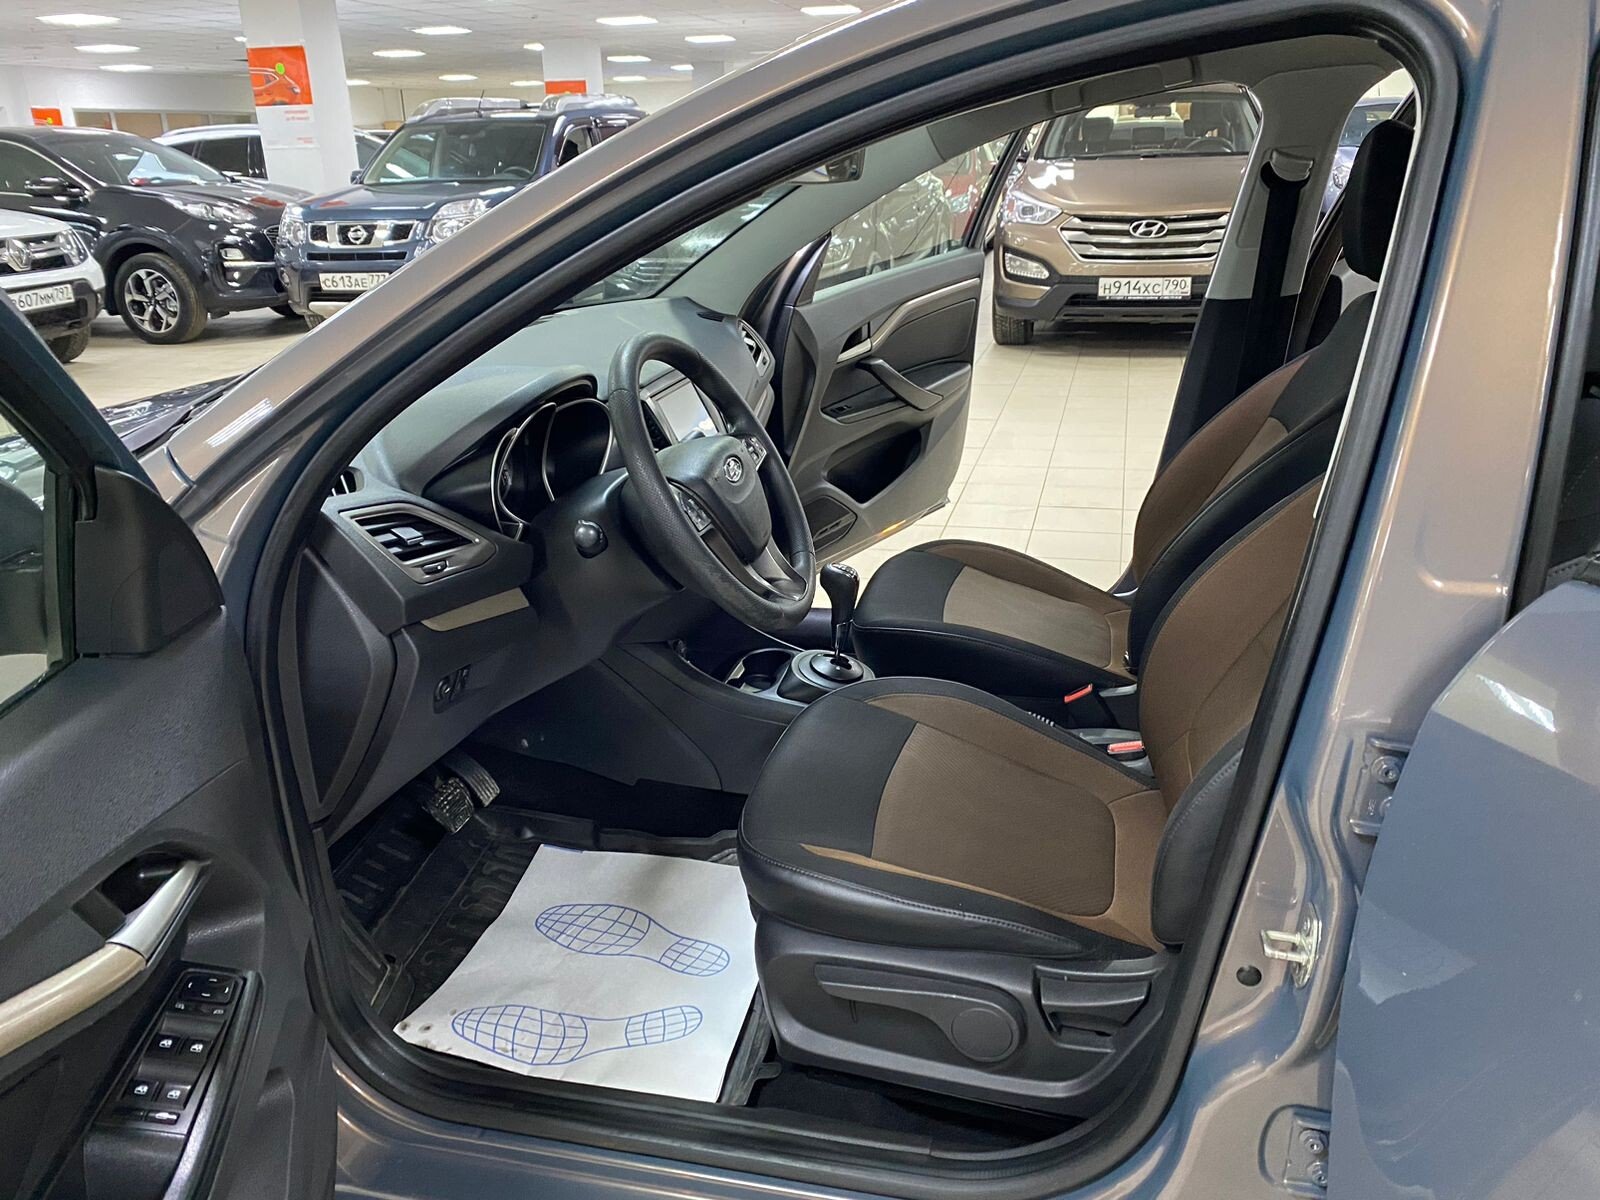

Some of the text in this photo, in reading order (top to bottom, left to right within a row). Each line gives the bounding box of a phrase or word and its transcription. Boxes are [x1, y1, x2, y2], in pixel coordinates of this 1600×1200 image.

[323, 275, 368, 288] С613АЕ
[1103, 279, 1187, 294] Н914ХС 790
